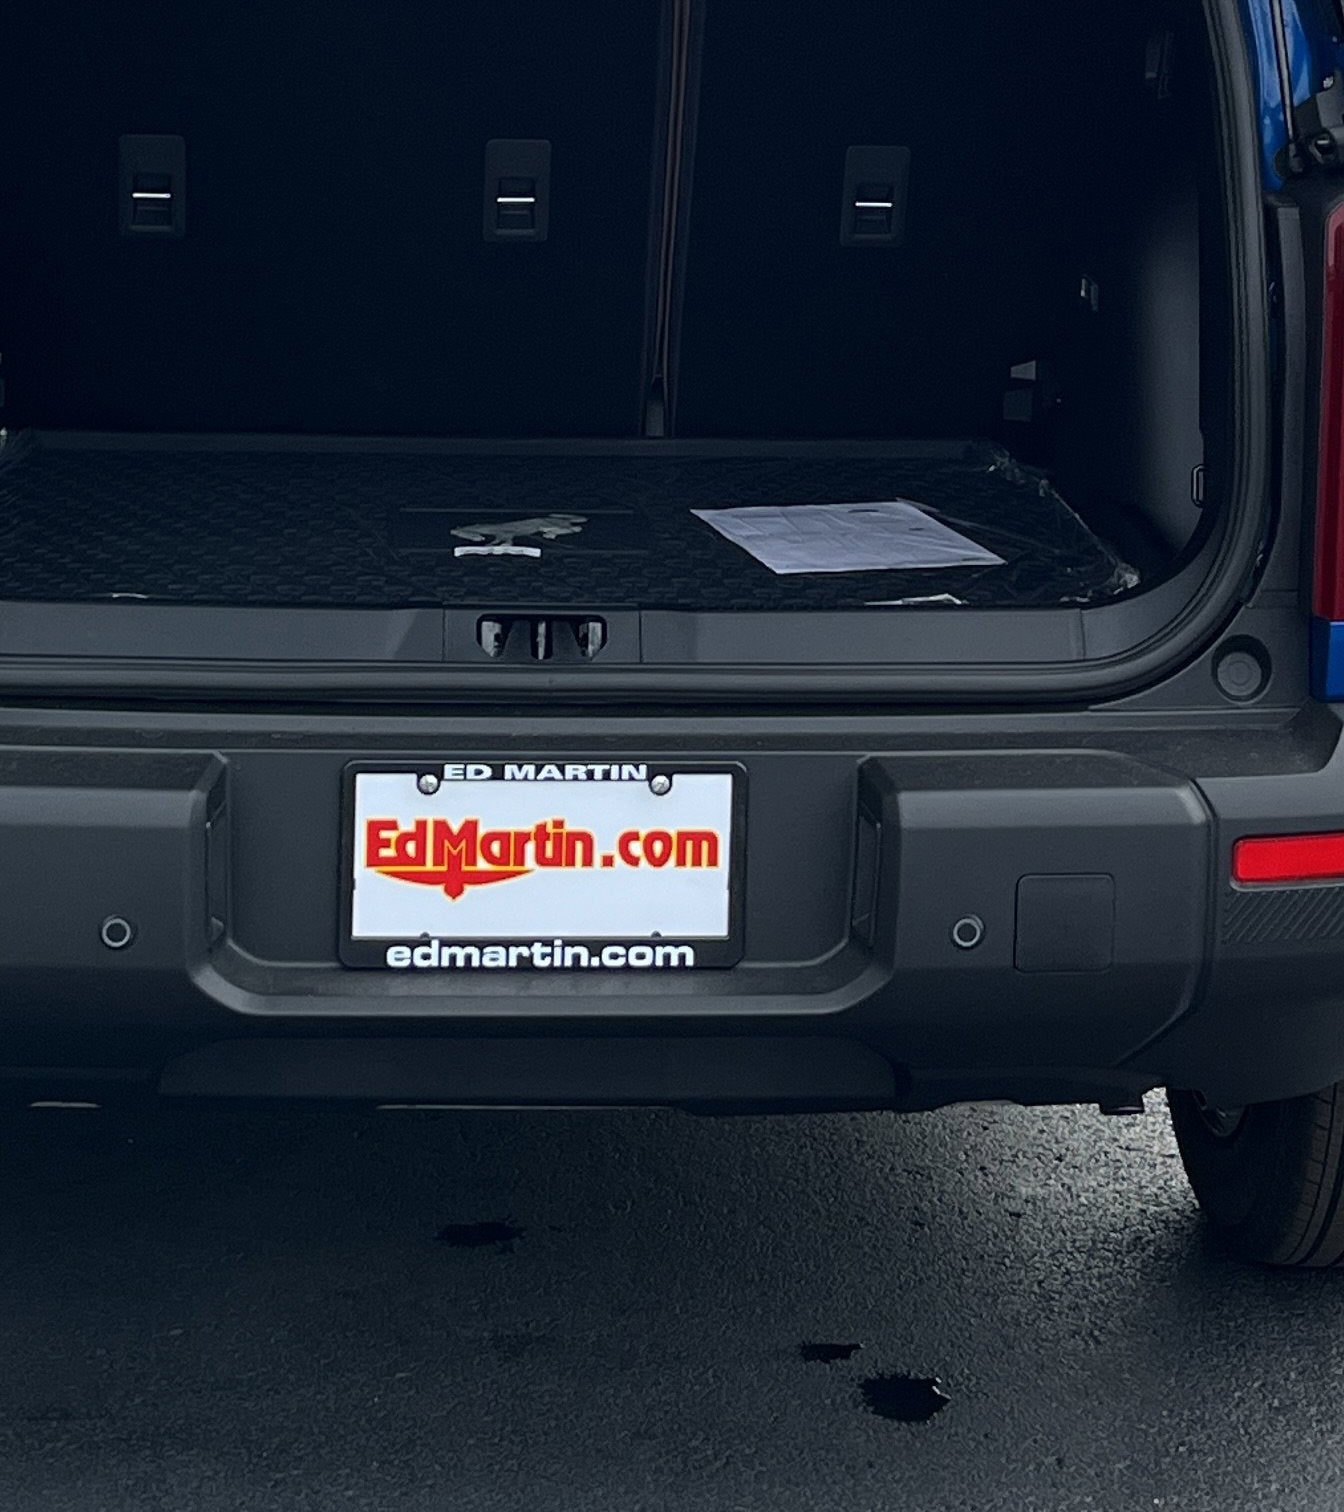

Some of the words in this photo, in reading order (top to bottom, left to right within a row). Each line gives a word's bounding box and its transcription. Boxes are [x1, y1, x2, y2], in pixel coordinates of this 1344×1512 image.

[442, 763, 493, 781] ED
[503, 764, 648, 782] MARTIN
[385, 939, 695, 969] edmartin.com
